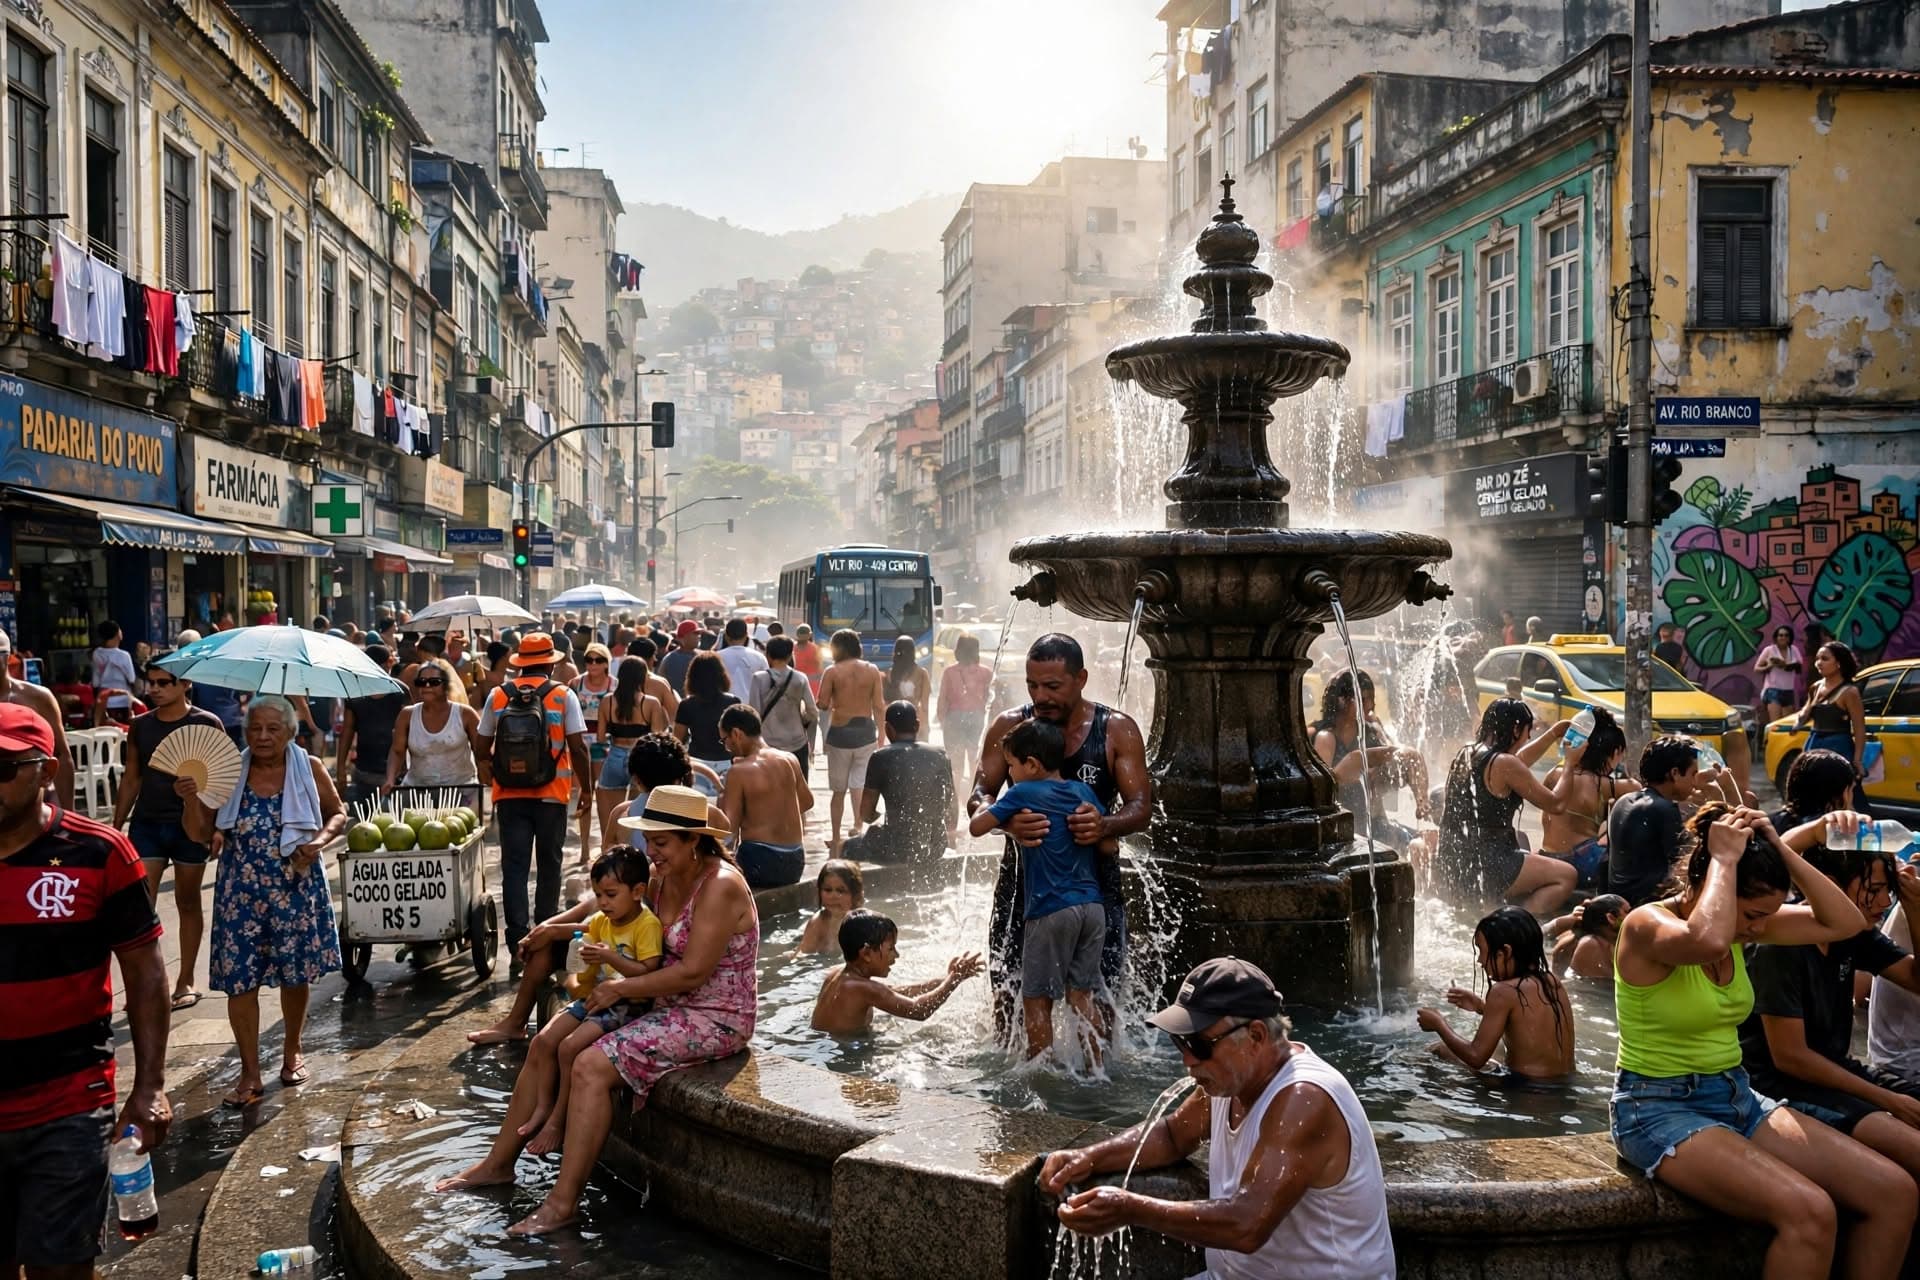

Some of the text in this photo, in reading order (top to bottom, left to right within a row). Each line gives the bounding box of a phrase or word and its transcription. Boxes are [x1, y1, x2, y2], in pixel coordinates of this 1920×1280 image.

[1660, 405, 1752, 419] AV. RIO BRANCO
[22, 404, 163, 476] PADARIA DO POVO
[207, 458, 280, 509] FARMÁCIA
[1475, 475, 1494, 491] BAR
[1496, 472, 1511, 488] DO
[1513, 463, 1529, 485] ZÉ
[1514, 484, 1548, 501] GELADA
[829, 559, 845, 571] VLT
[848, 559, 863, 571] RIO
[870, 560, 887, 571] 409
[352, 860, 388, 881] ÁGUA
[392, 860, 444, 880] GELADA
[394, 881, 447, 901] GELADO
[382, 905, 421, 930] R$ 5
